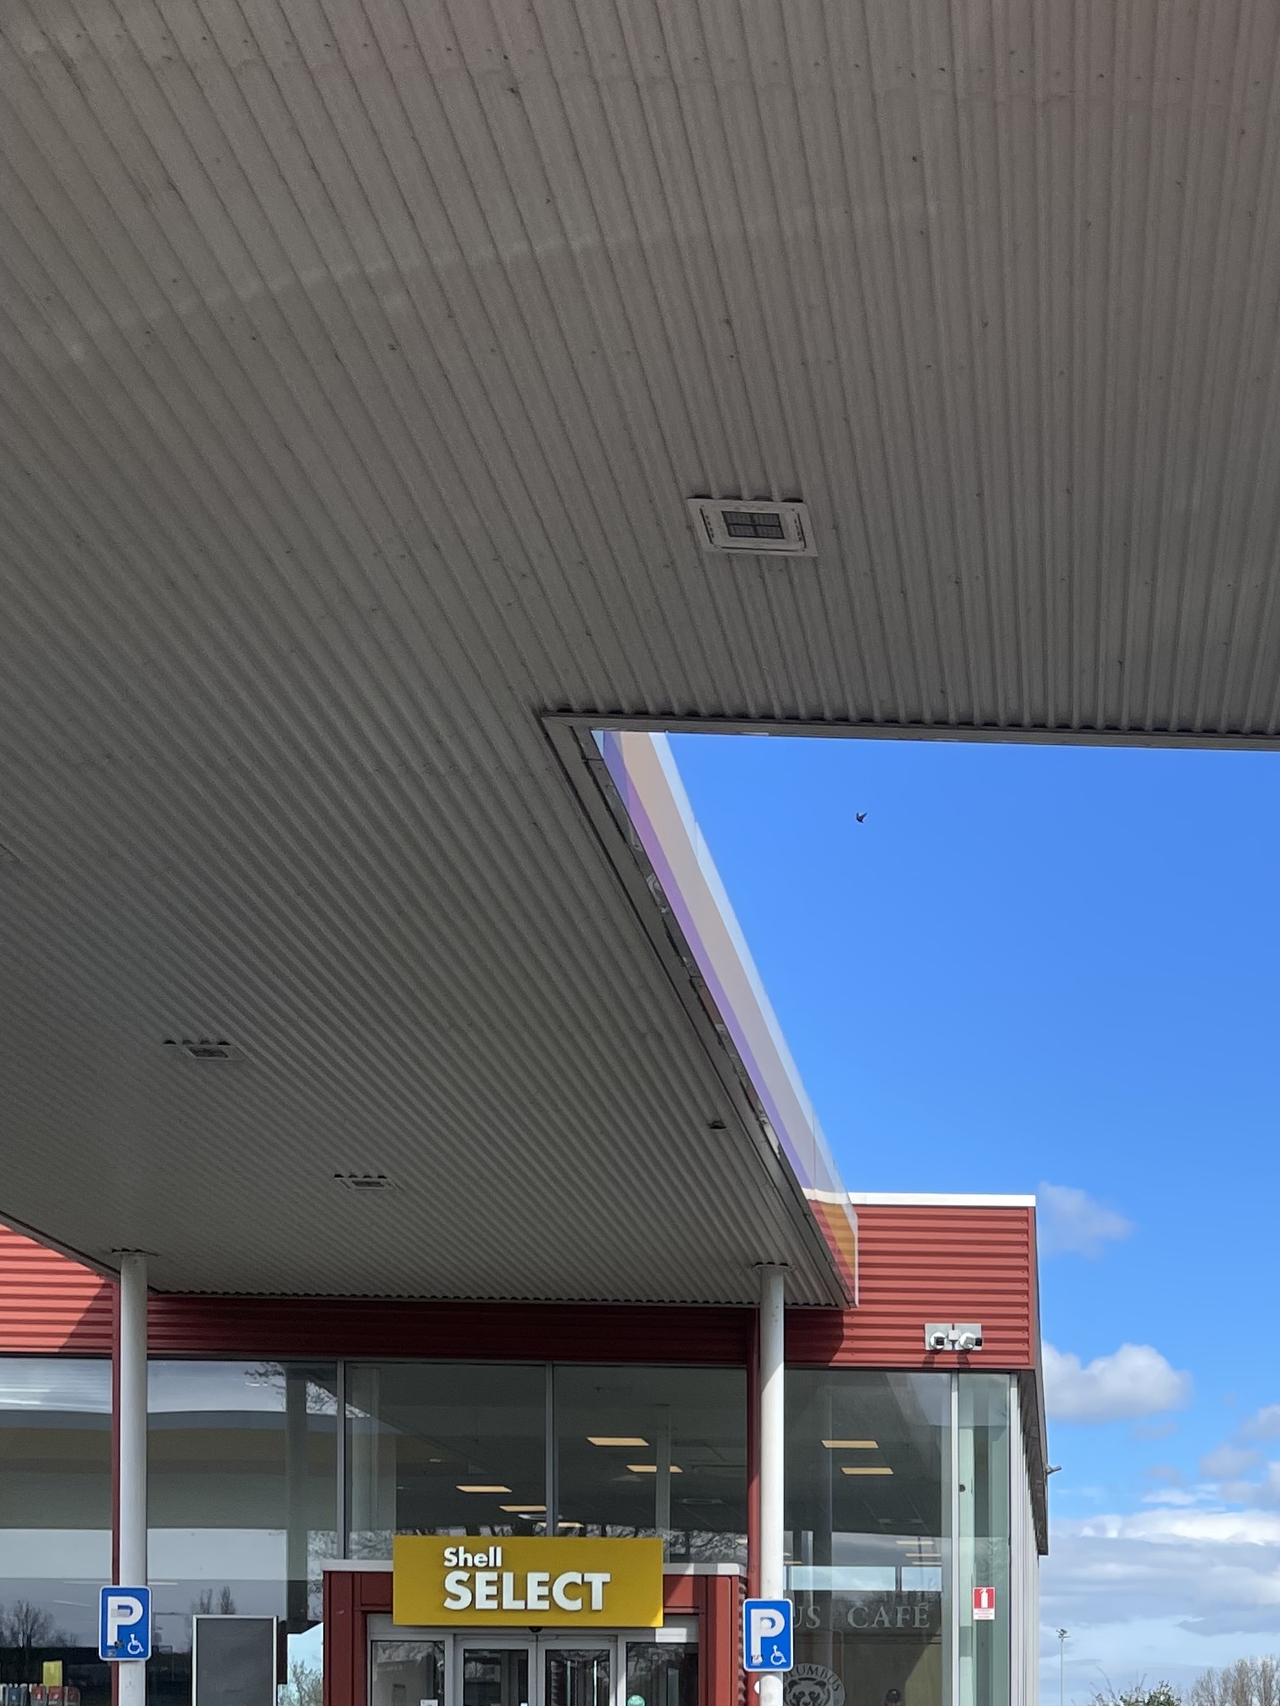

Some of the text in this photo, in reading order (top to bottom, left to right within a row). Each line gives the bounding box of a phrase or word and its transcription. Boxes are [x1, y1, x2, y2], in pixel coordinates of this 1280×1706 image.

[443, 1546, 503, 1568] Shell
[443, 1570, 612, 1612] SELECT
[107, 1595, 144, 1647] P
[750, 1608, 786, 1665] P
[847, 1602, 931, 1630] CAFÉ
